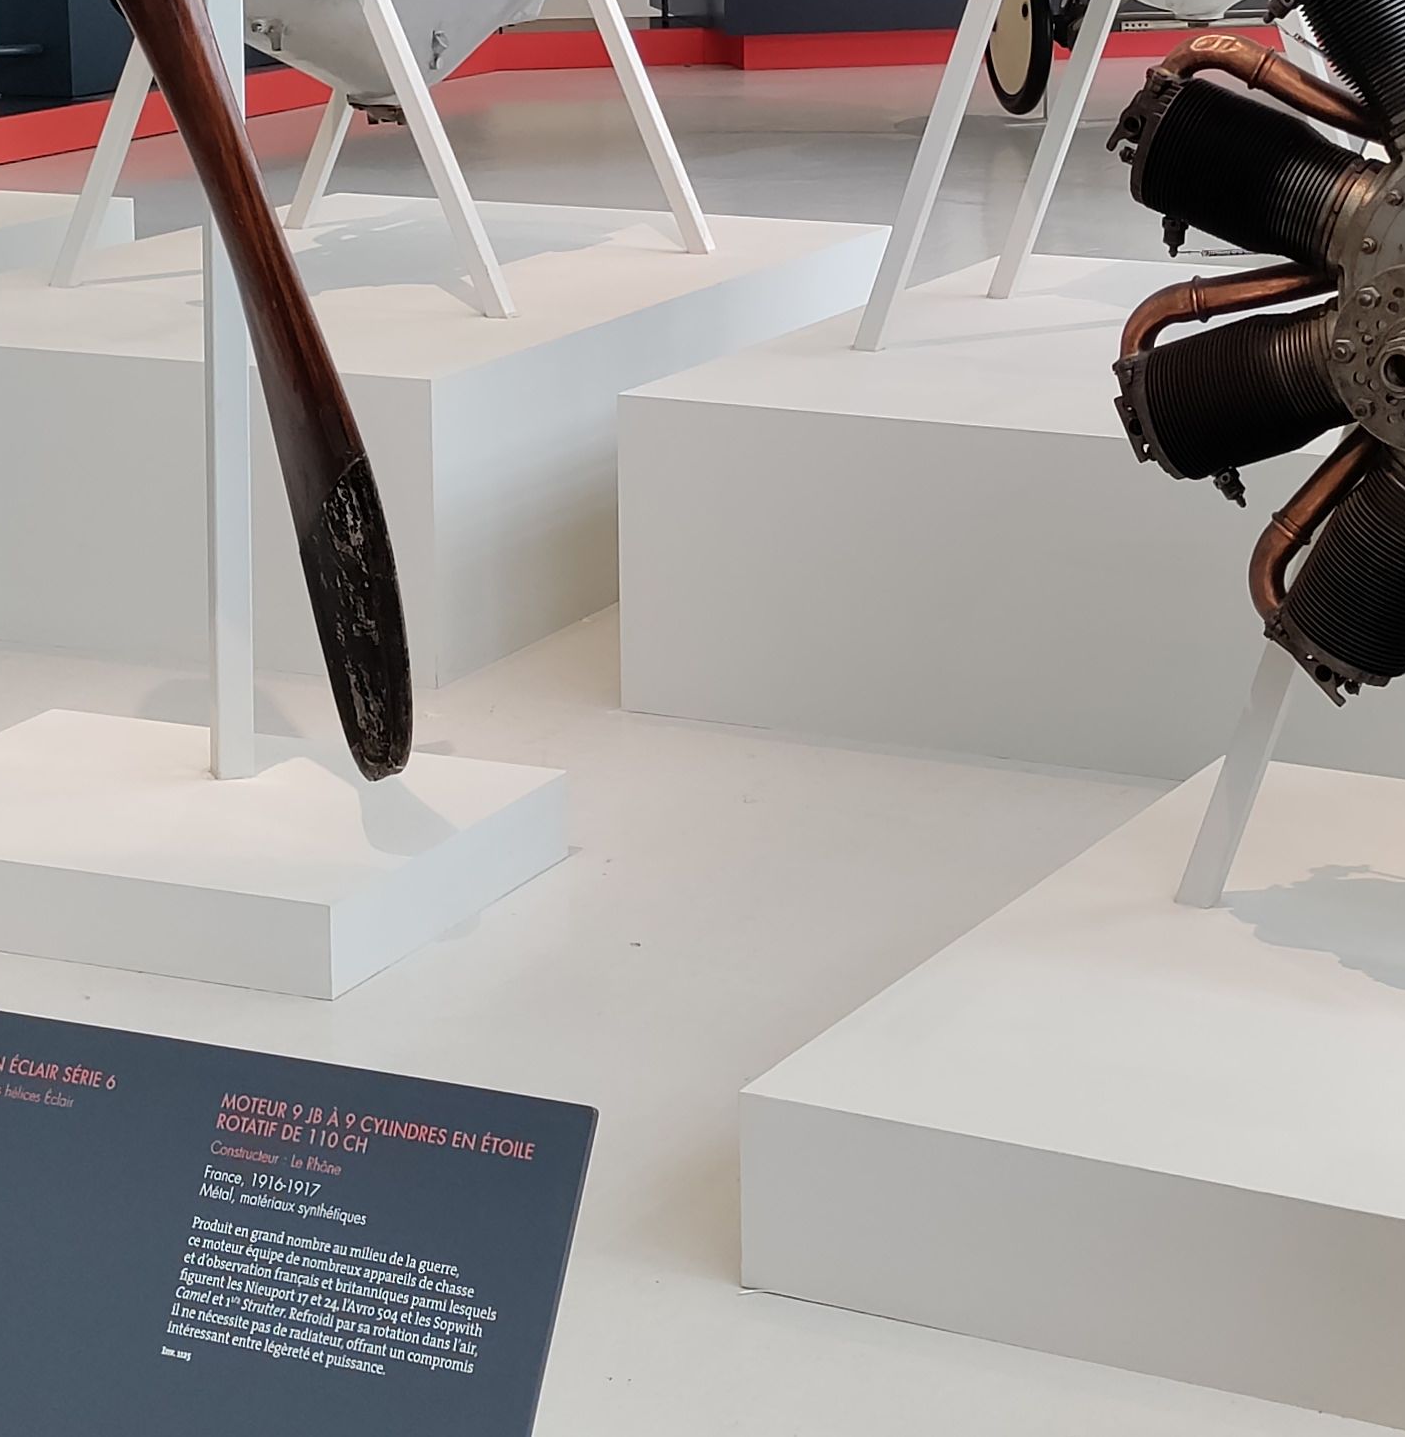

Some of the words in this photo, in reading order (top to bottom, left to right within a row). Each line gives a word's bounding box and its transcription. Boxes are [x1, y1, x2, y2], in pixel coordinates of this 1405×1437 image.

[4, 1083, 40, 1102] hélices
[44, 1089, 74, 1107] Éclair
[9, 1054, 59, 1080] ÉCLAIR
[62, 1064, 102, 1087] SÉRIE
[105, 1074, 116, 1090] 6
[216, 1113, 277, 1137] ROTATIF
[281, 1123, 303, 1142] DE
[309, 1128, 338, 1148] 110
[343, 1134, 368, 1154] CH
[221, 1093, 287, 1118] MOTEUR
[292, 1104, 303, 1120] 9
[304, 1107, 322, 1124] JB
[326, 1106, 338, 1127] À
[345, 1113, 356, 1129] 9
[360, 1116, 447, 1144] CYLINDRES
[451, 1131, 476, 1150] EN
[480, 1132, 535, 1160] ÉTOILE
[203, 1164, 244, 1187] France,
[252, 1173, 321, 1196] 1916-1917
[210, 1140, 279, 1163] Constructeur
[290, 1154, 303, 1168] Le
[306, 1156, 341, 1175] Rhône
[198, 1182, 235, 1204] Métal,
[239, 1193, 295, 1212] matériaux
[297, 1203, 366, 1225] synthétiques
[187, 1236, 201, 1247] ce
[201, 1238, 244, 1254] moteur
[245, 1244, 284, 1263] équipe
[285, 1250, 301, 1265] de
[301, 1256, 362, 1276] nombreux
[363, 1268, 417, 1287] appareils
[418, 1272, 434, 1290] de
[435, 1279, 474, 1298] chasse
[191, 1215, 233, 1235] Produit
[234, 1226, 249, 1238] en
[249, 1229, 285, 1244] grand
[285, 1235, 331, 1252] nombre
[331, 1244, 348, 1256] au
[349, 1246, 387, 1263] milieu
[388, 1251, 404, 1266] de
[404, 1253, 416, 1269] la
[417, 1260, 459, 1278] guerre,
[179, 1267, 225, 1288] figurent
[226, 1275, 243, 1291] les
[244, 1280, 295, 1301] Nieuport
[296, 1292, 309, 1306] 17
[309, 1293, 323, 1307] et
[323, 1297, 340, 1312] 24,
[341, 1297, 375, 1316] l'Avro
[375, 1303, 398, 1323] 504
[400, 1307, 414, 1324] et
[413, 1311, 431, 1327] les
[432, 1316, 482, 1337] Sopwith
[183, 1251, 196, 1265] et
[197, 1253, 271, 1278] d'observation
[273, 1266, 320, 1287] français
[320, 1277, 334, 1290] et
[335, 1278, 409, 1304] britanniques
[410, 1295, 447, 1311] parmi
[448, 1299, 497, 1320] lesquels
[167, 1320, 230, 1344] intéressant
[231, 1335, 262, 1350] entre
[263, 1338, 310, 1360] légèreté
[311, 1350, 324, 1363] et
[324, 1354, 385, 1375] puissance.
[170, 1302, 180, 1316] il
[180, 1307, 196, 1319] ne
[197, 1309, 249, 1329] nécessite
[249, 1320, 271, 1334] pas
[272, 1322, 288, 1337] de
[288, 1327, 344, 1349] radiateur,
[345, 1337, 387, 1356] offrant
[389, 1347, 405, 1360] un
[407, 1351, 473, 1373] compromis
[175, 1286, 212, 1303] Camel
[211, 1293, 224, 1306] et
[240, 1298, 286, 1318] Strutter.
[288, 1306, 334, 1327] Refroidi
[334, 1318, 357, 1331] par
[356, 1323, 370, 1334] sa
[372, 1325, 419, 1344] rotation
[421, 1332, 451, 1350] dans
[452, 1337, 477, 1357] l'air,
